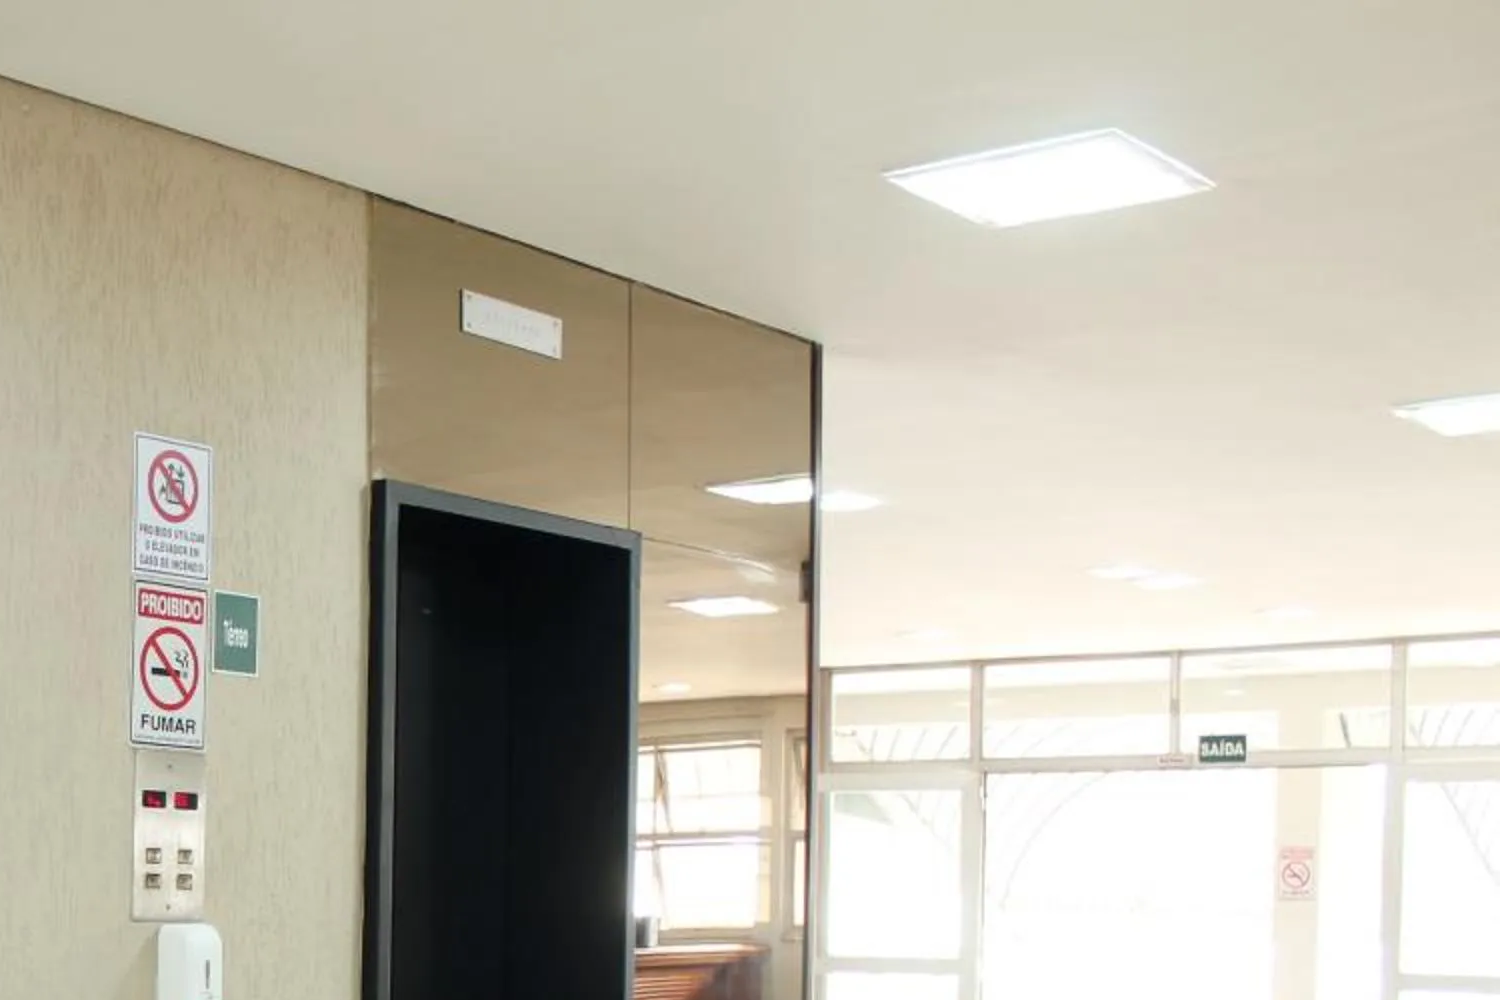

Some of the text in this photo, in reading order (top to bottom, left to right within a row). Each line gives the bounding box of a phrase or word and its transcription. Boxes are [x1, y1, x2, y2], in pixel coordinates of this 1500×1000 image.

[140, 592, 201, 620] PROIBIDO
[141, 714, 196, 735] FUMAR
[1201, 739, 1244, 757] SAÍDA
